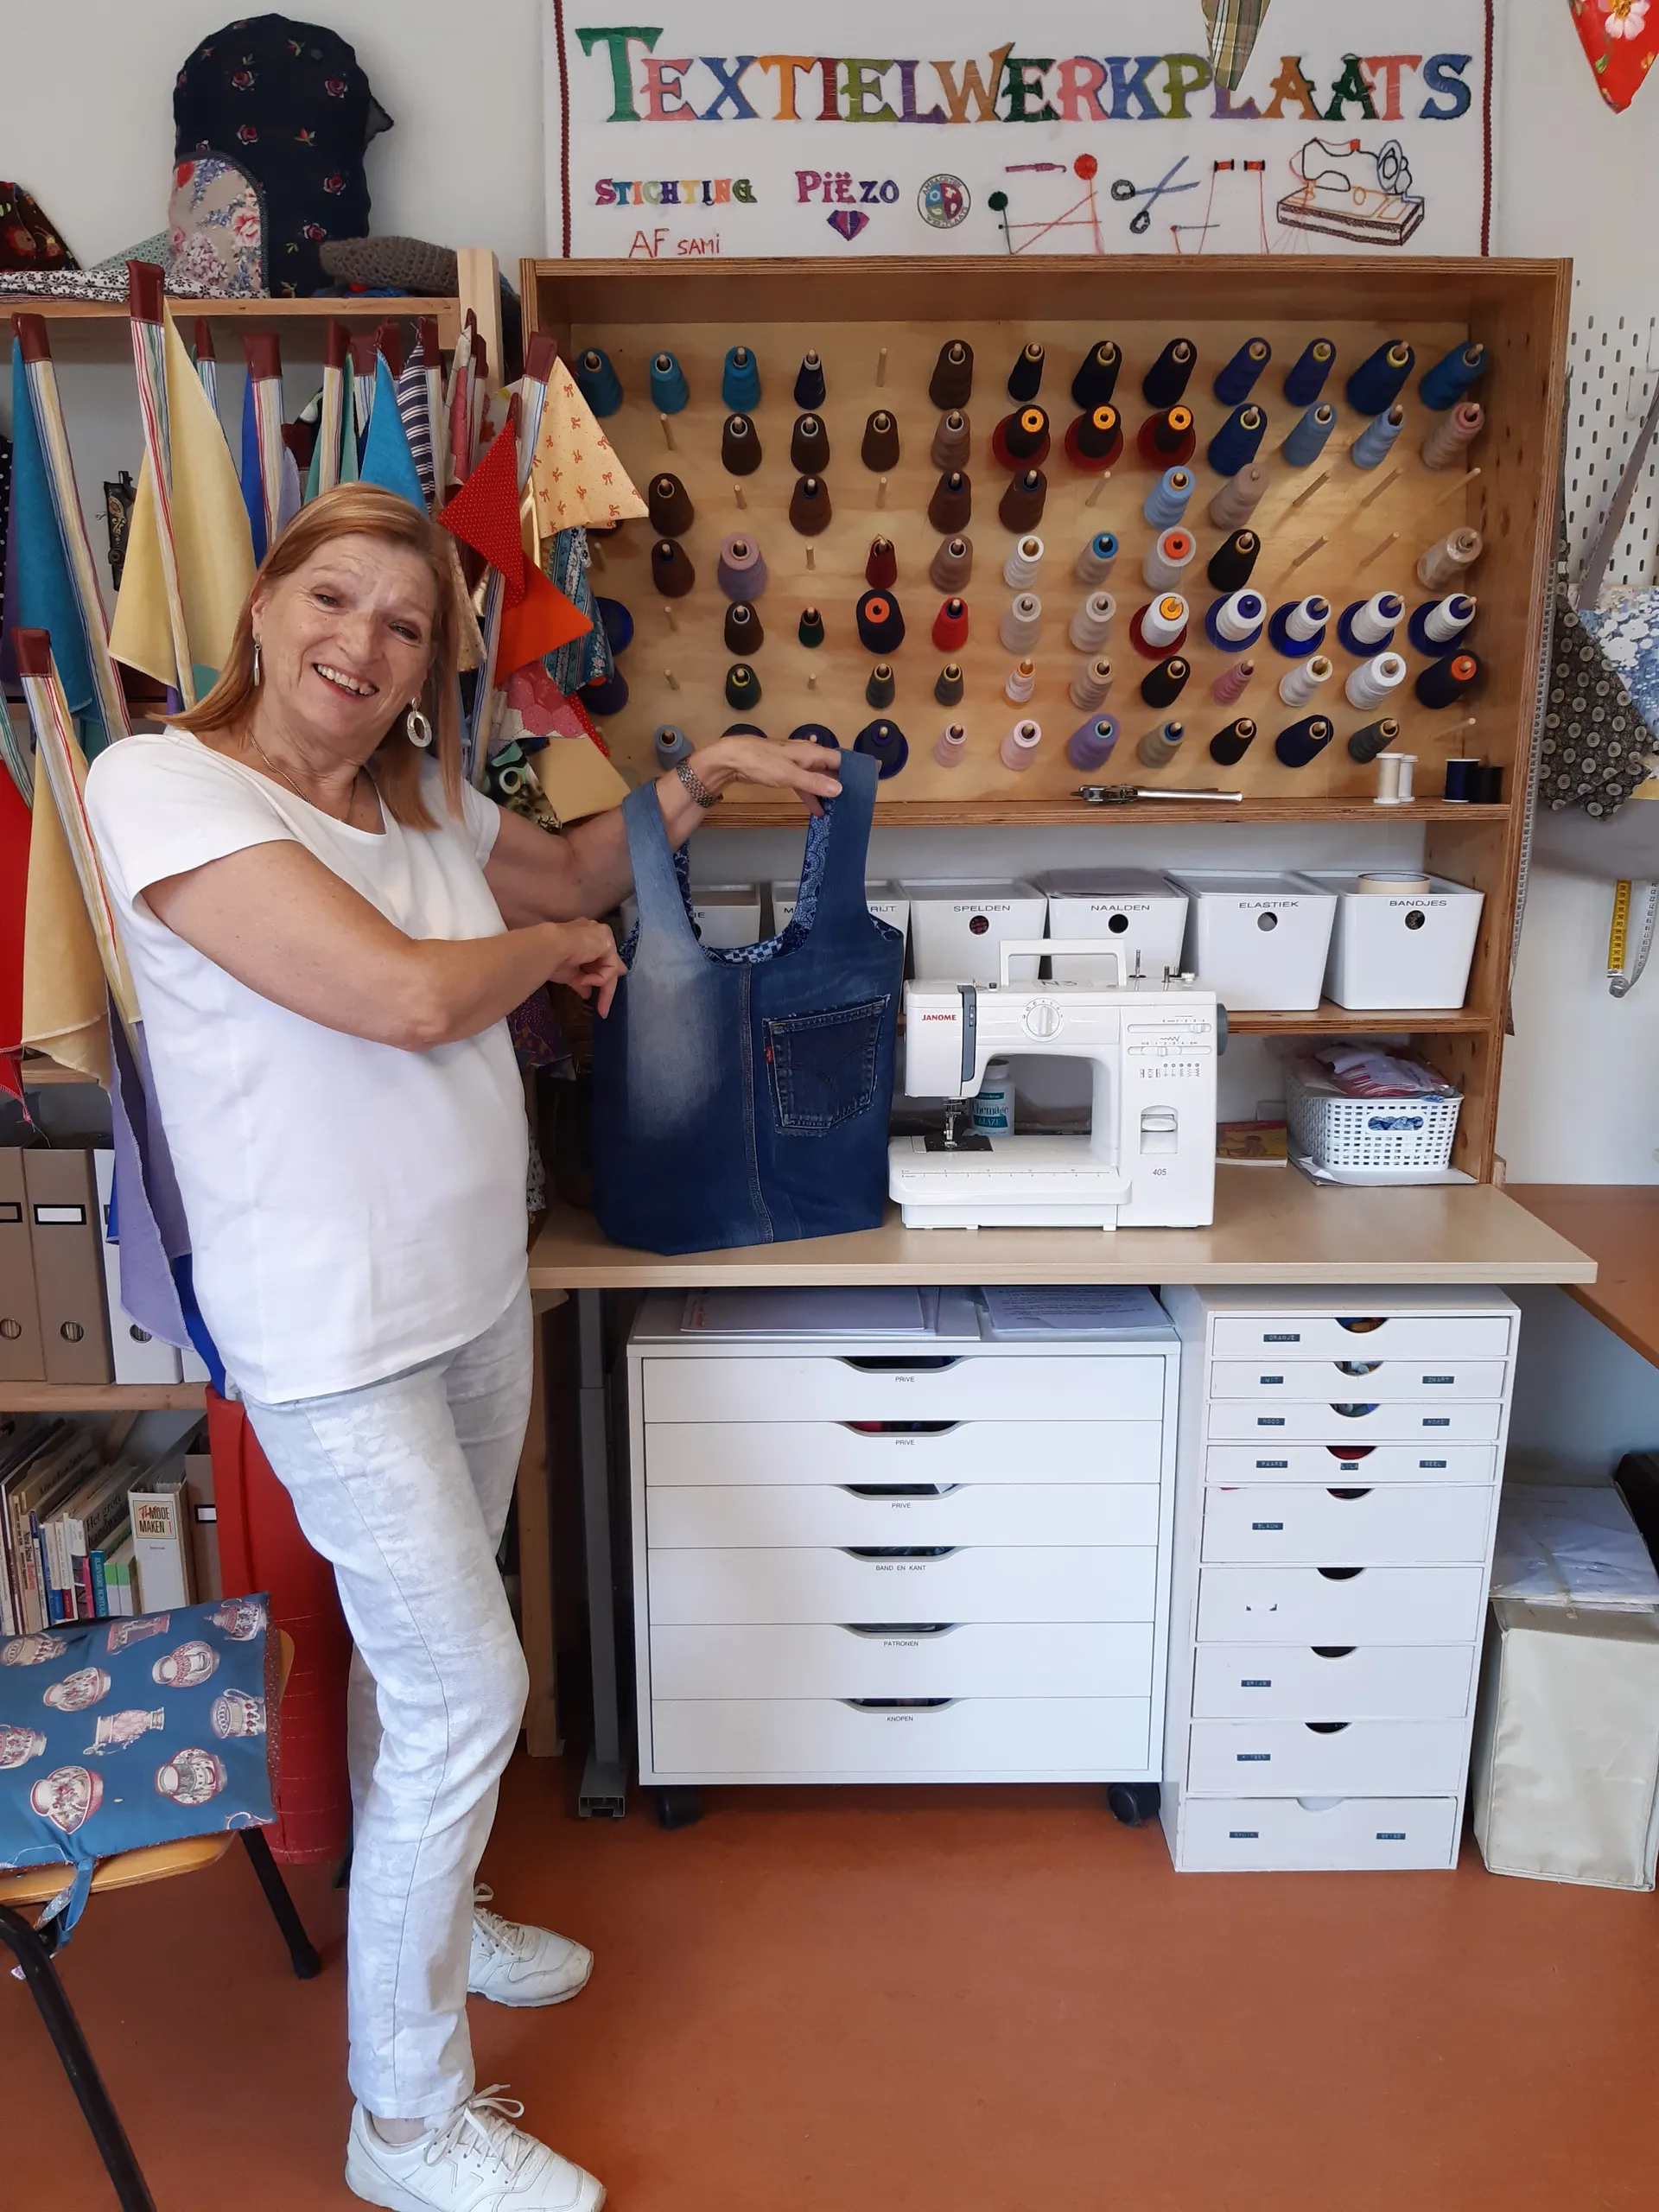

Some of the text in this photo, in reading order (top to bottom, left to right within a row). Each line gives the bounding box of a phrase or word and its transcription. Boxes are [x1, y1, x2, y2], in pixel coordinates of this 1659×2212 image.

[575, 27, 1473, 124] TEXTIELWERKPLAATS
[594, 177, 758, 207] STICHTING
[628, 227, 671, 258] AF
[139, 1520, 165, 1534] MAKEN
